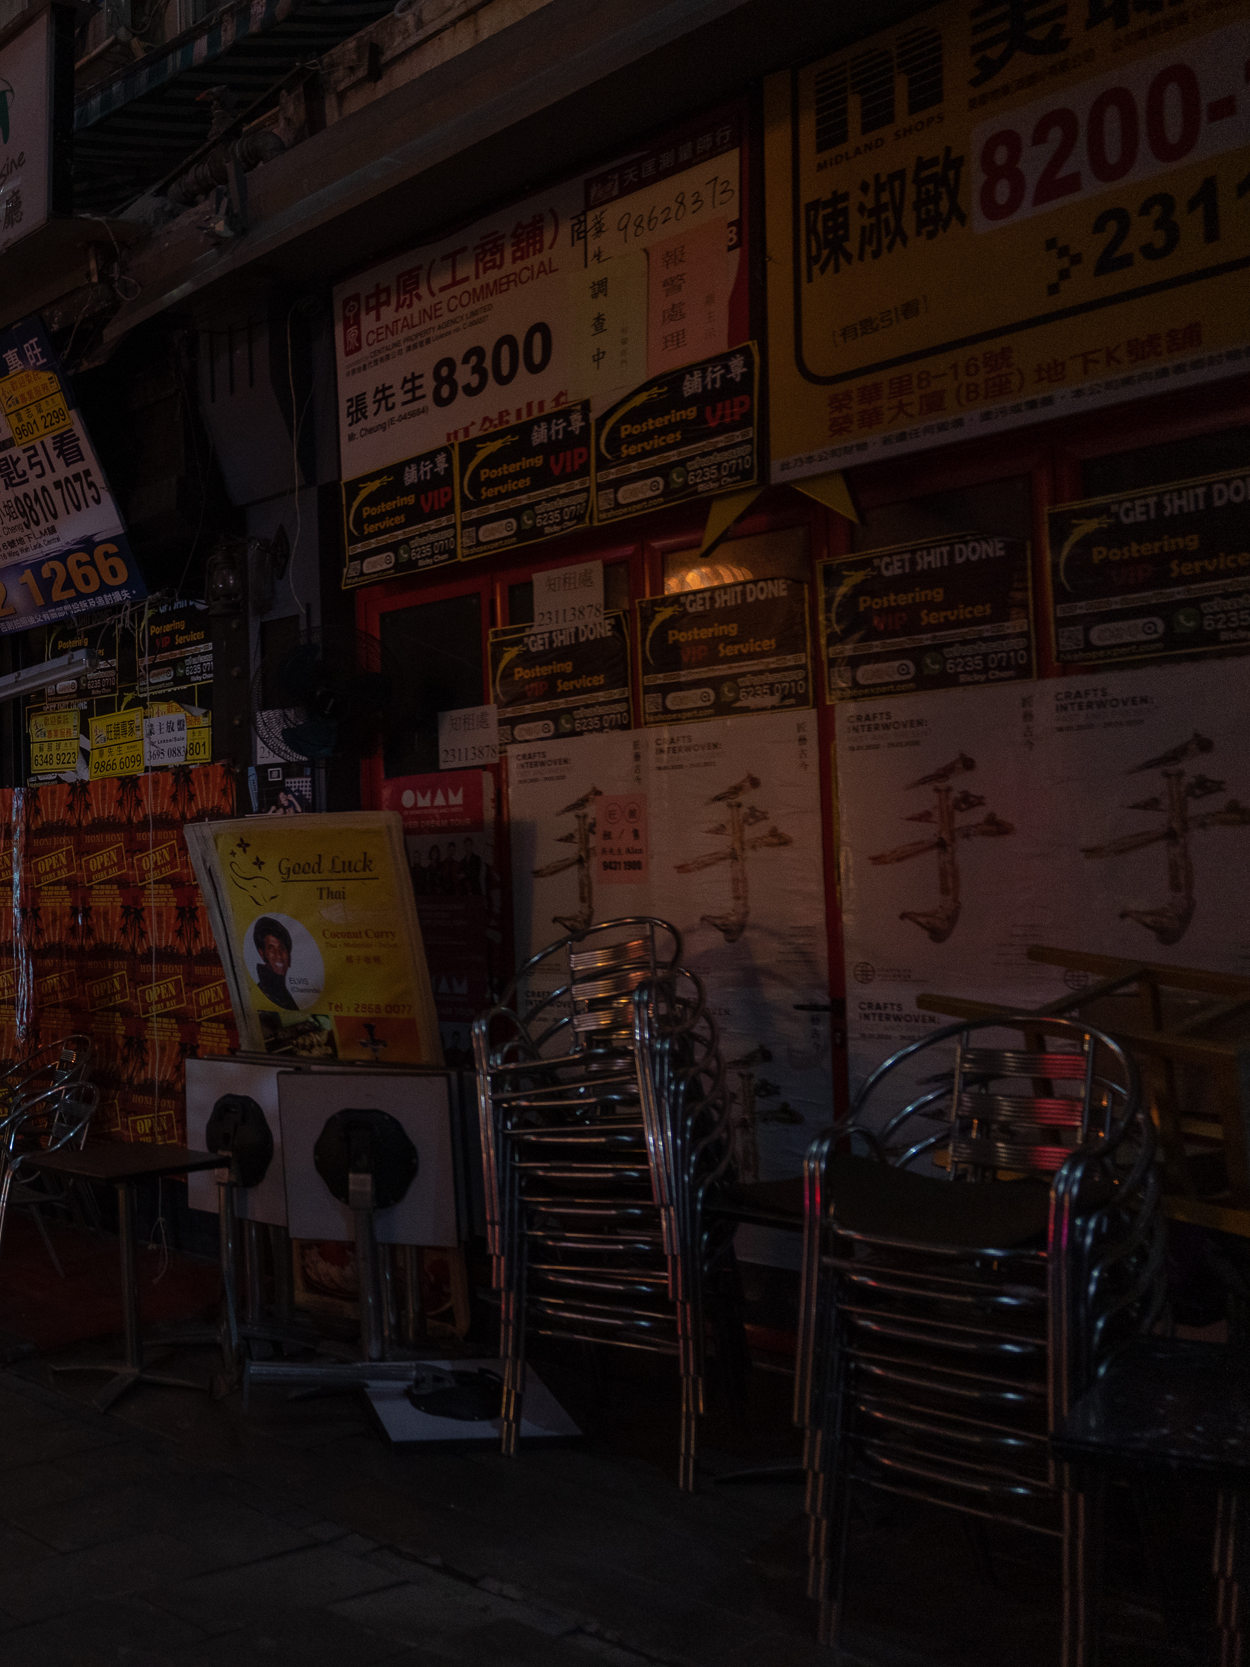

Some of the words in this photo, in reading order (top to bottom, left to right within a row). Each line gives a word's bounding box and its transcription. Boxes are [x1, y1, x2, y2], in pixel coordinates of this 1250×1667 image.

[816, 138, 885, 172] MIDLAND
[893, 112, 946, 142] SHOPS
[616, 175, 736, 244] 98628373
[803, 146, 967, 283] 陳淑敏
[364, 206, 560, 323] 中原(工商舖)
[365, 300, 444, 348] CENTALINE
[446, 256, 560, 314] COMMERCIAL
[660, 244, 688, 353] 報警處理
[403, 325, 436, 347] PROPERTY
[437, 316, 465, 332] AGENCY
[466, 303, 494, 320] LIMITED
[589, 276, 609, 371] 調查中
[345, 371, 427, 428] 張先生
[432, 321, 553, 410] 8300
[14, 418, 41, 440] 9601
[40, 407, 67, 430] 2299
[620, 406, 698, 439] Postering
[704, 394, 751, 428] VIP
[359, 421, 387, 439] Cheung
[620, 430, 683, 458] Services
[479, 455, 544, 482] Postering
[549, 446, 589, 476] VIP
[687, 465, 719, 485] 6235
[720, 455, 751, 474] 0710
[14, 485, 59, 530] 9810
[52, 468, 103, 516] 7075
[480, 476, 531, 500] Services
[1162, 485, 1208, 518] SHIT
[1212, 477, 1250, 508] DO
[362, 493, 416, 519] Postering
[419, 486, 452, 514] VIP
[2, 523, 25, 537] Cheng
[363, 513, 406, 535] Services
[535, 511, 561, 528] 6235
[410, 544, 432, 561] 6235
[432, 537, 455, 554] 0710
[915, 545, 951, 572] SHIT
[954, 537, 1006, 564] DONE
[1091, 533, 1200, 564] Postering
[17, 542, 131, 609] 1266
[1169, 550, 1250, 578] Service
[713, 583, 744, 610] SHIT
[858, 586, 945, 613] Postering
[537, 603, 603, 628] 23113878
[919, 603, 992, 626] Services
[174, 630, 205, 646] Services
[551, 625, 577, 649] SHIT
[667, 622, 739, 645] Postering
[717, 637, 777, 658] Services
[513, 660, 574, 682] Postering
[945, 655, 985, 674] 6235
[987, 649, 1028, 669] 0710
[556, 673, 605, 693] Services
[738, 685, 771, 702] 6235
[772, 679, 807, 697] 0710
[1054, 687, 1109, 703] CRAFTS
[574, 716, 601, 732] 6235
[601, 711, 629, 727] 0710
[847, 711, 892, 723] CRAFTS
[34, 753, 55, 768] 6348
[55, 751, 78, 766] 9223
[93, 758, 118, 774] 9866
[118, 754, 142, 770] 6099
[441, 743, 500, 764] 23113878
[515, 750, 547, 761] CRAFTS
[401, 786, 464, 809] OMAM
[420, 818, 448, 829] DREAM
[449, 816, 472, 826] TOUR
[158, 830, 178, 840] HONI
[36, 852, 68, 874] OPEN
[88, 849, 119, 872] OPEN
[141, 847, 171, 871] OPEN
[278, 853, 323, 881] Good
[327, 851, 374, 874] Luck
[316, 886, 346, 901] Thai
[322, 928, 363, 940] Coconut
[363, 927, 396, 941] Curry
[161, 964, 183, 975] HONI
[288, 976, 309, 985] ELVIS
[40, 974, 69, 997] OPEN
[92, 977, 122, 999] OPEN
[145, 981, 177, 1004] OPEN
[198, 985, 225, 1007] OPEN
[327, 1001, 343, 1013] Tel
[384, 1003, 413, 1014] 0077
[858, 1001, 903, 1012] CRAFTS
